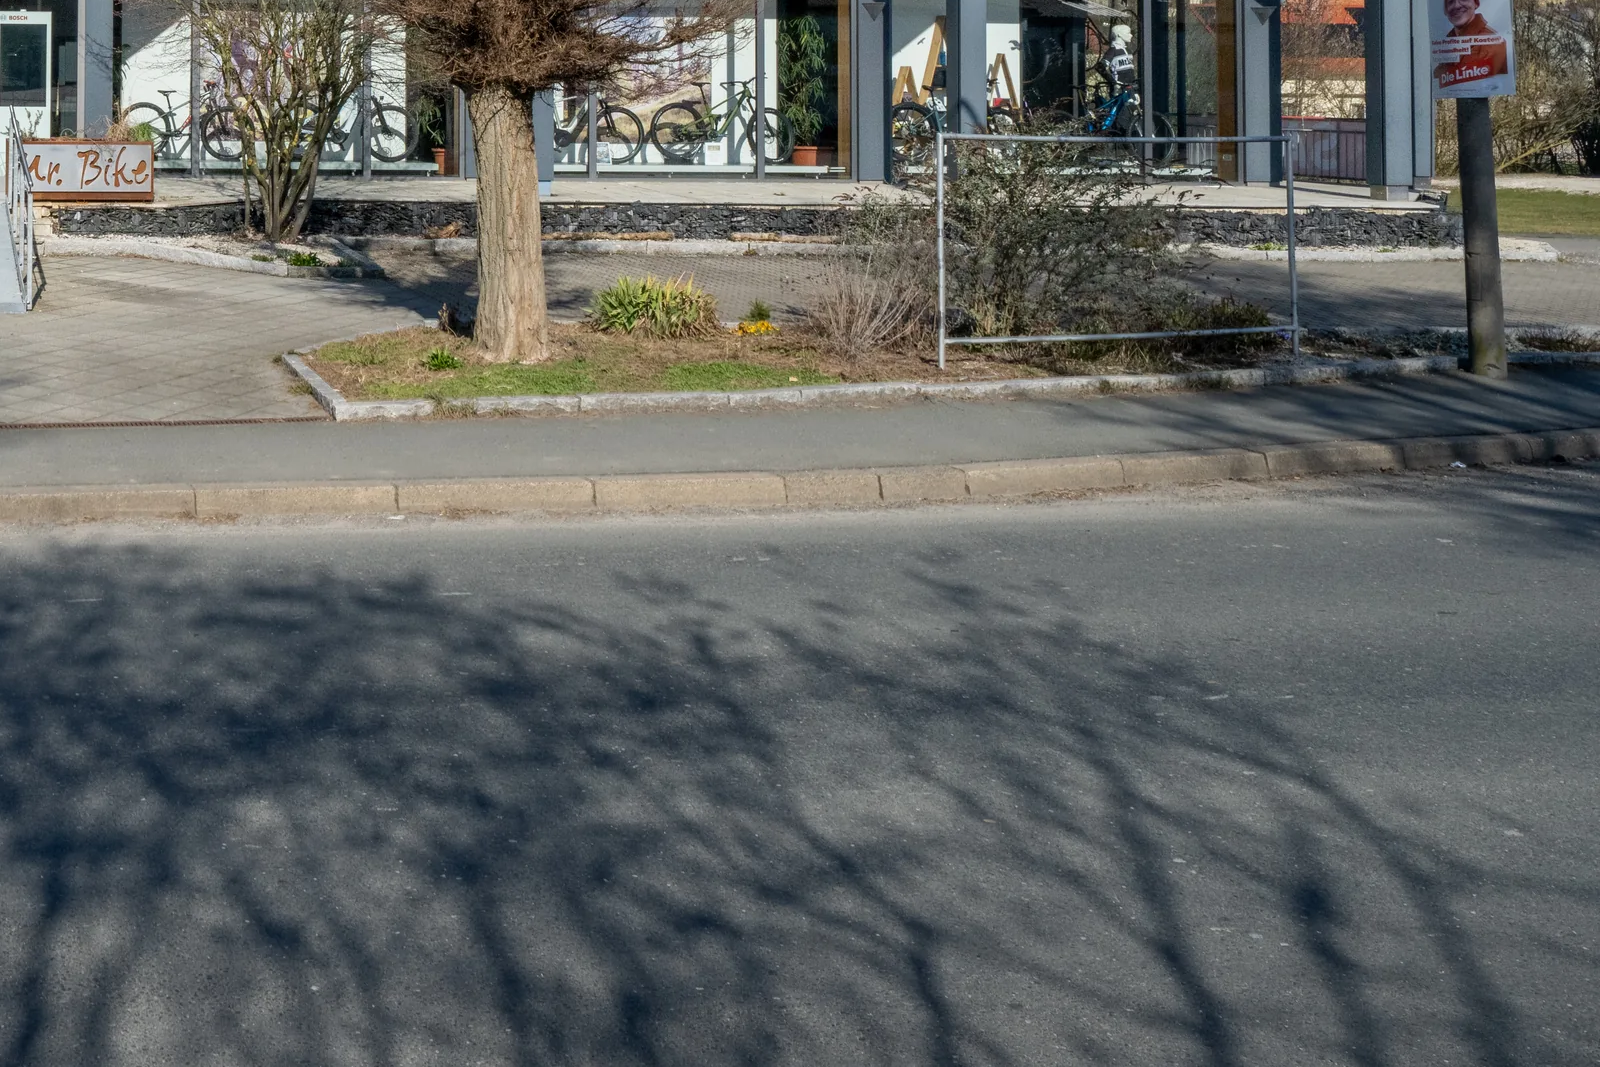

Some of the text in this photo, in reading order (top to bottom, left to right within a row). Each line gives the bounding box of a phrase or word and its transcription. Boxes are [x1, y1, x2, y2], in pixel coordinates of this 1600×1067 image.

[1441, 65, 1489, 84] Die Linke
[77, 146, 150, 189] Bike
